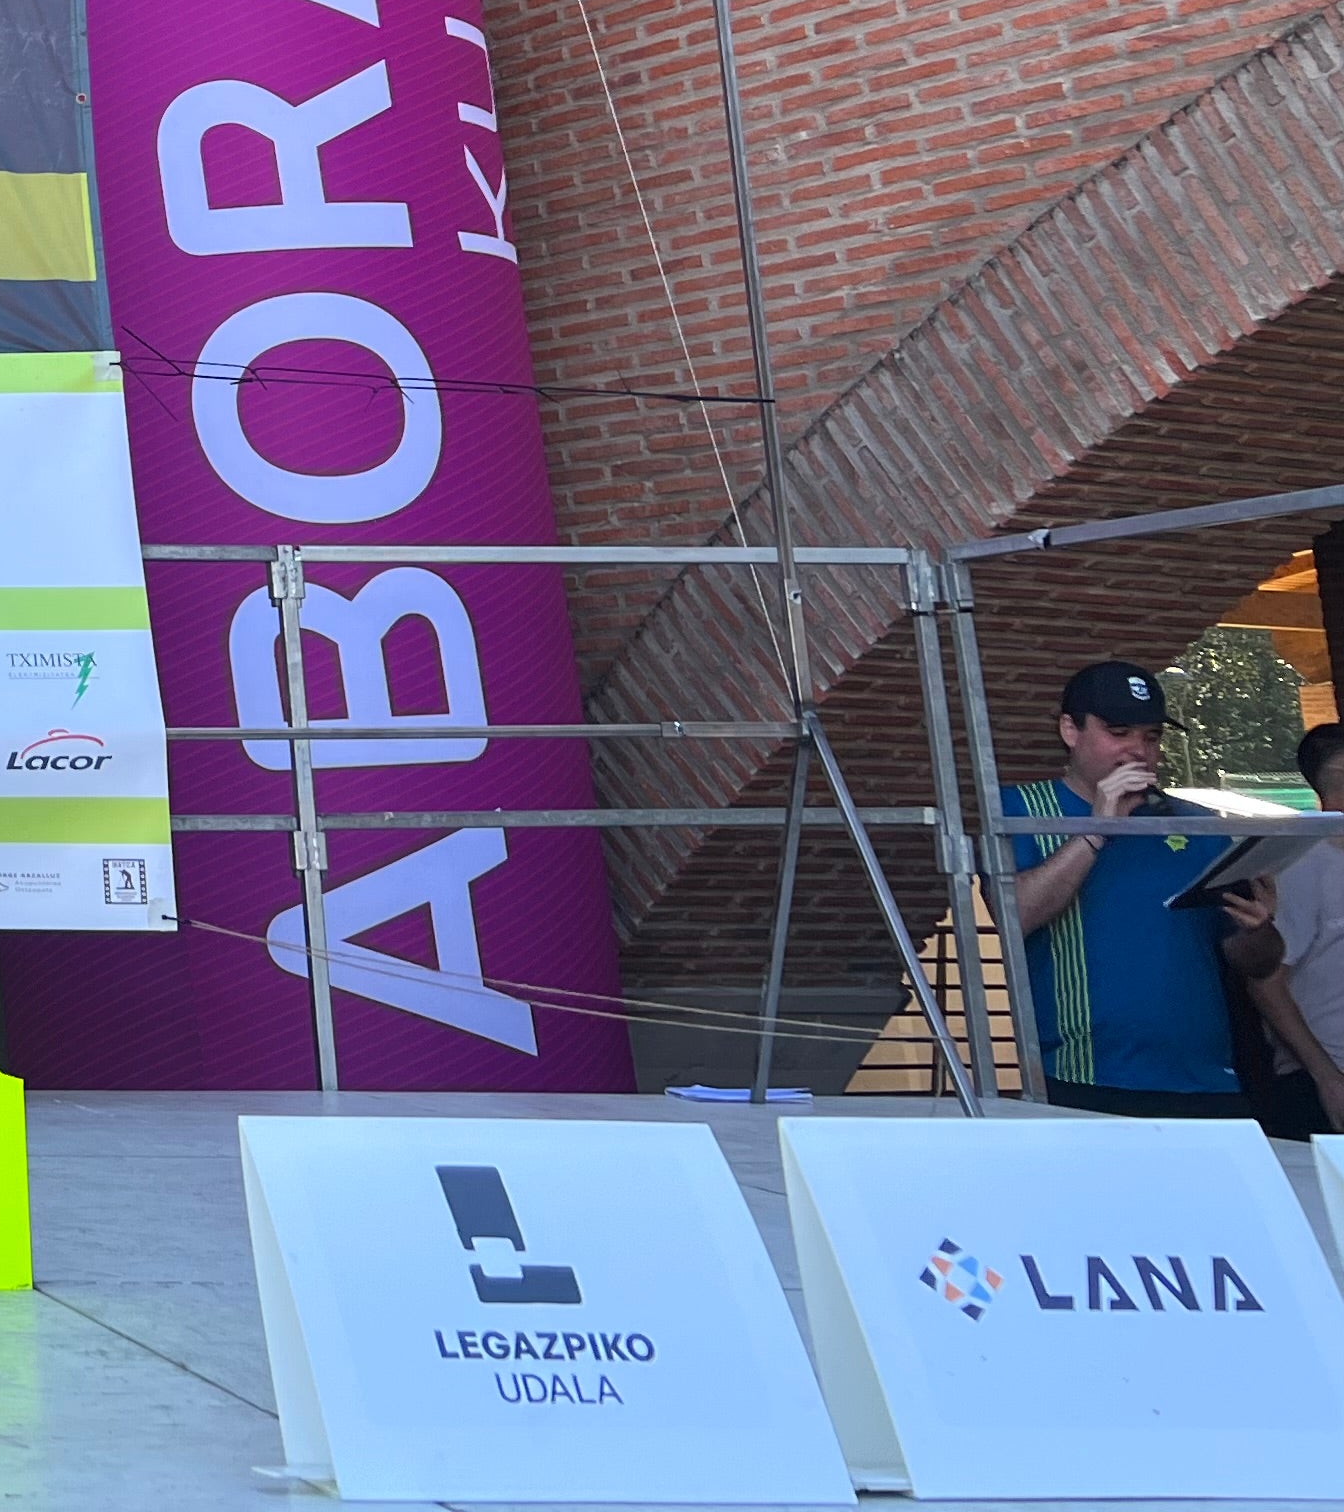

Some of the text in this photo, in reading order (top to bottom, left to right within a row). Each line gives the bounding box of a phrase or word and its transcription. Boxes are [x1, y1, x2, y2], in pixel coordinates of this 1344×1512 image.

[6, 652, 98, 668] TXIMISTA
[6, 751, 113, 771] Lacor
[1019, 1254, 1266, 1313] LANA
[433, 1328, 656, 1365] LEGAZPIKO
[492, 1372, 625, 1407] UDALA
